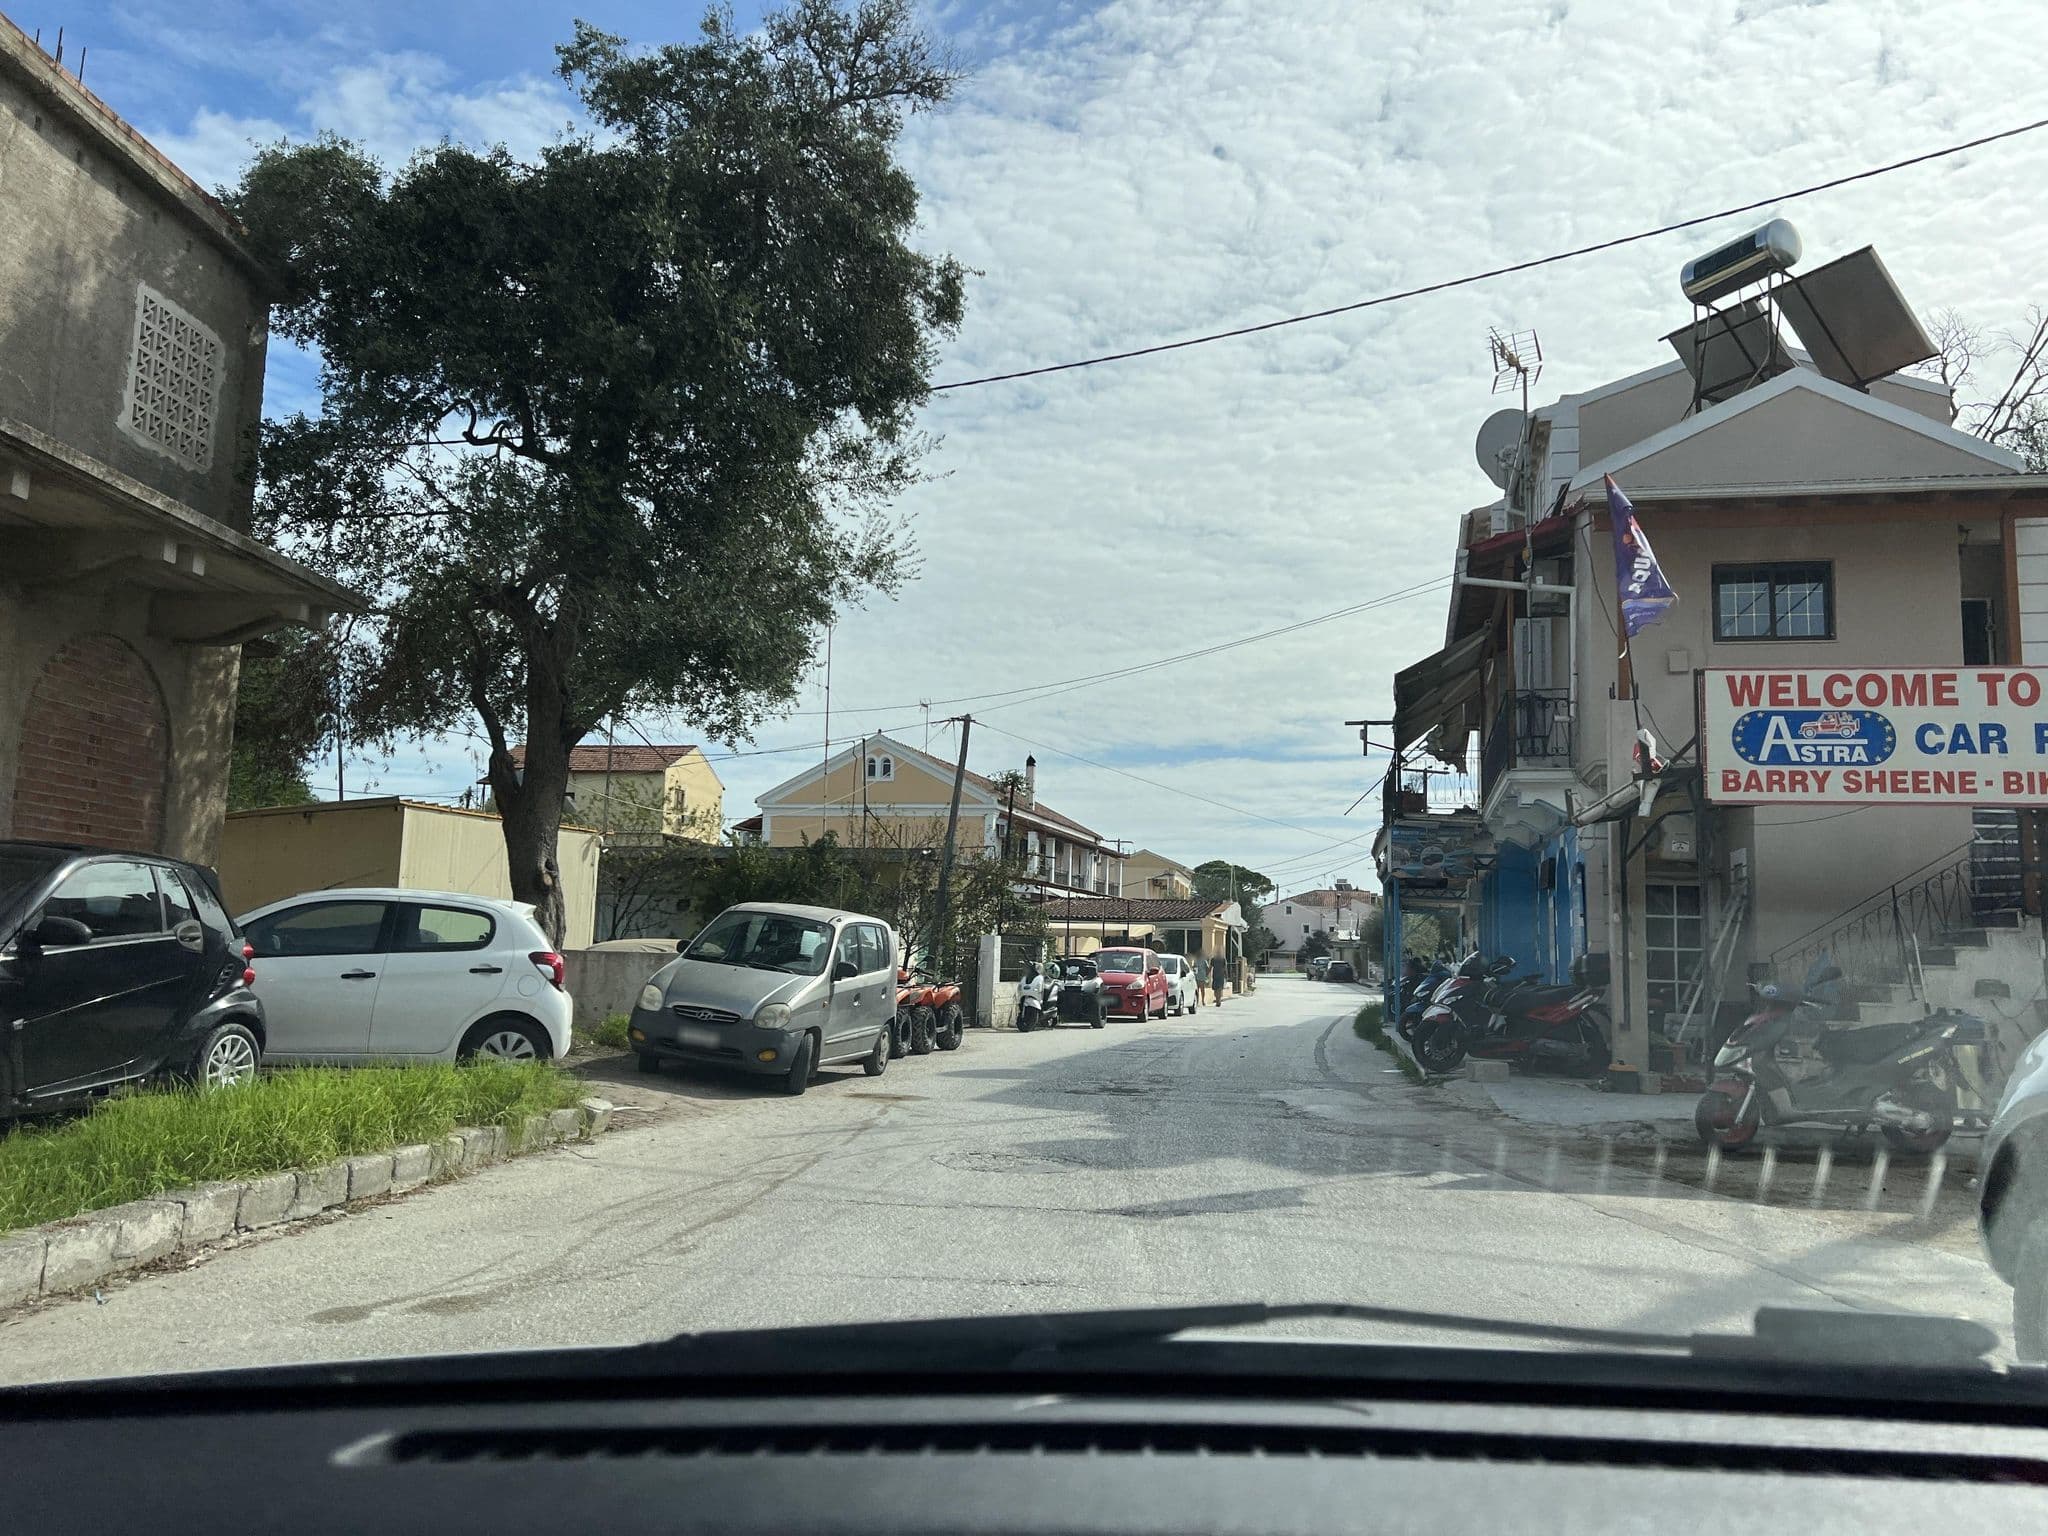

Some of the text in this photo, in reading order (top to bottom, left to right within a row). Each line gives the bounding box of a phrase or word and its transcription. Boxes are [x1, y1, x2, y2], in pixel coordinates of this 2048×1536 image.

[1726, 672, 2041, 707] WELCOME TO
[1758, 715, 1869, 763] ASTRA
[1915, 722, 2009, 755] CAR
[1722, 769, 1832, 793] BARRY
[1843, 770, 1978, 794] SHEENE
